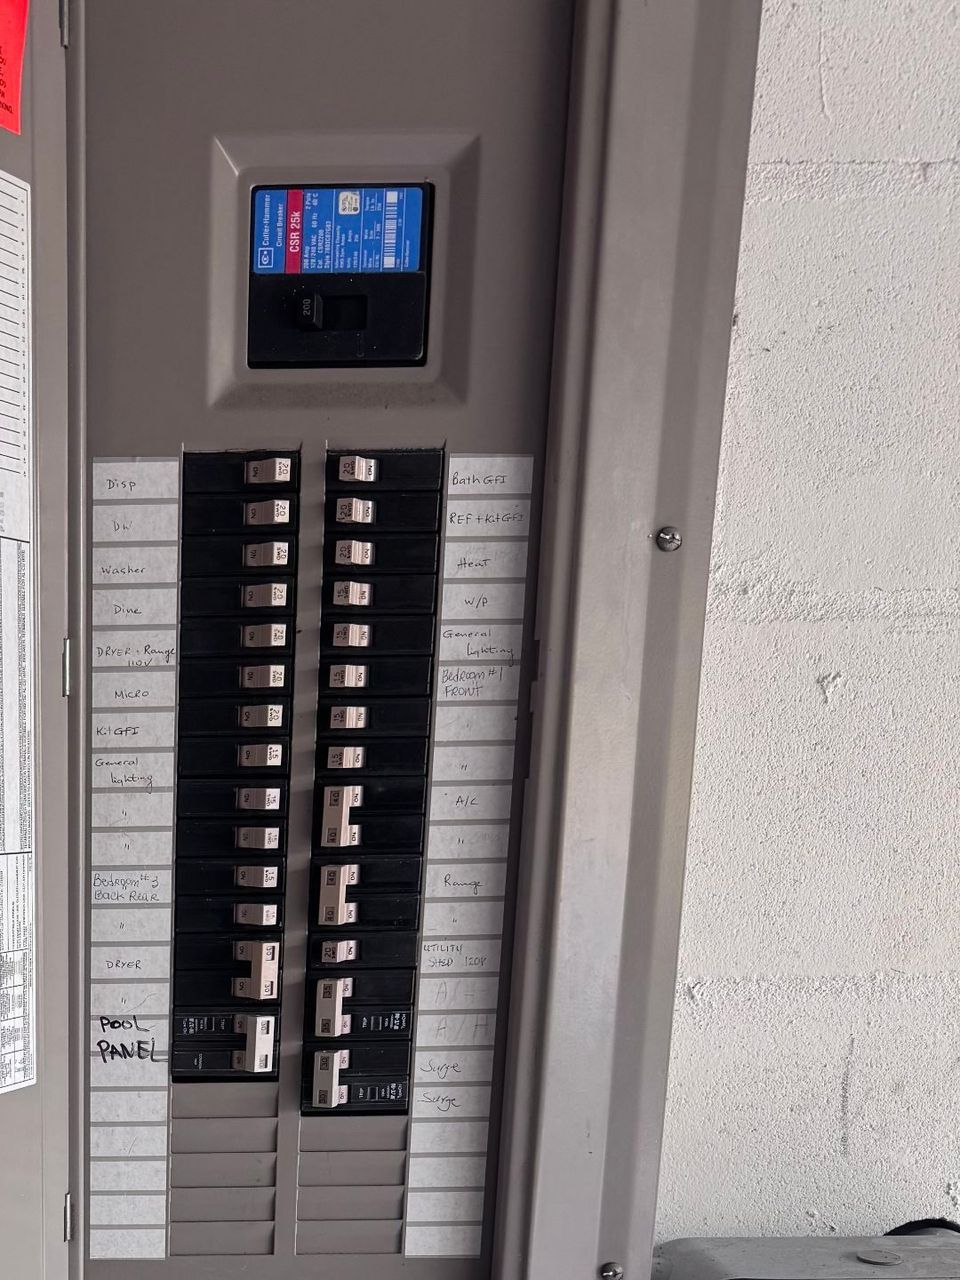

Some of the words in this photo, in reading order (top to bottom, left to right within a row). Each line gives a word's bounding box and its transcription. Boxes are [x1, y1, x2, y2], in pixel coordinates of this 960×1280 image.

[262, 194, 271, 246] Cutler-Hammer
[276, 203, 284, 226] Breaker
[290, 211, 301, 230] 25k
[289, 232, 300, 253] CSR
[303, 299, 311, 316] 200
[282, 462, 289, 475] 20
[343, 462, 350, 475] 20
[367, 464, 373, 476] ON
[452, 471, 480, 486] Bath
[107, 479, 136, 492] Disp
[280, 505, 286, 517] 20
[449, 512, 473, 524] REF
[280, 548, 287, 560] 20
[340, 546, 346, 558] 20
[364, 548, 370, 559] ON
[101, 564, 146, 575] Washer
[277, 587, 284, 600] 20
[442, 629, 491, 639] General
[96, 646, 131, 658] DRYER
[144, 643, 176, 664] Range
[95, 757, 139, 767] General
[106, 960, 141, 969] DRYER
[100, 1015, 150, 1033] POOL
[97, 1037, 169, 1064] PANEL
